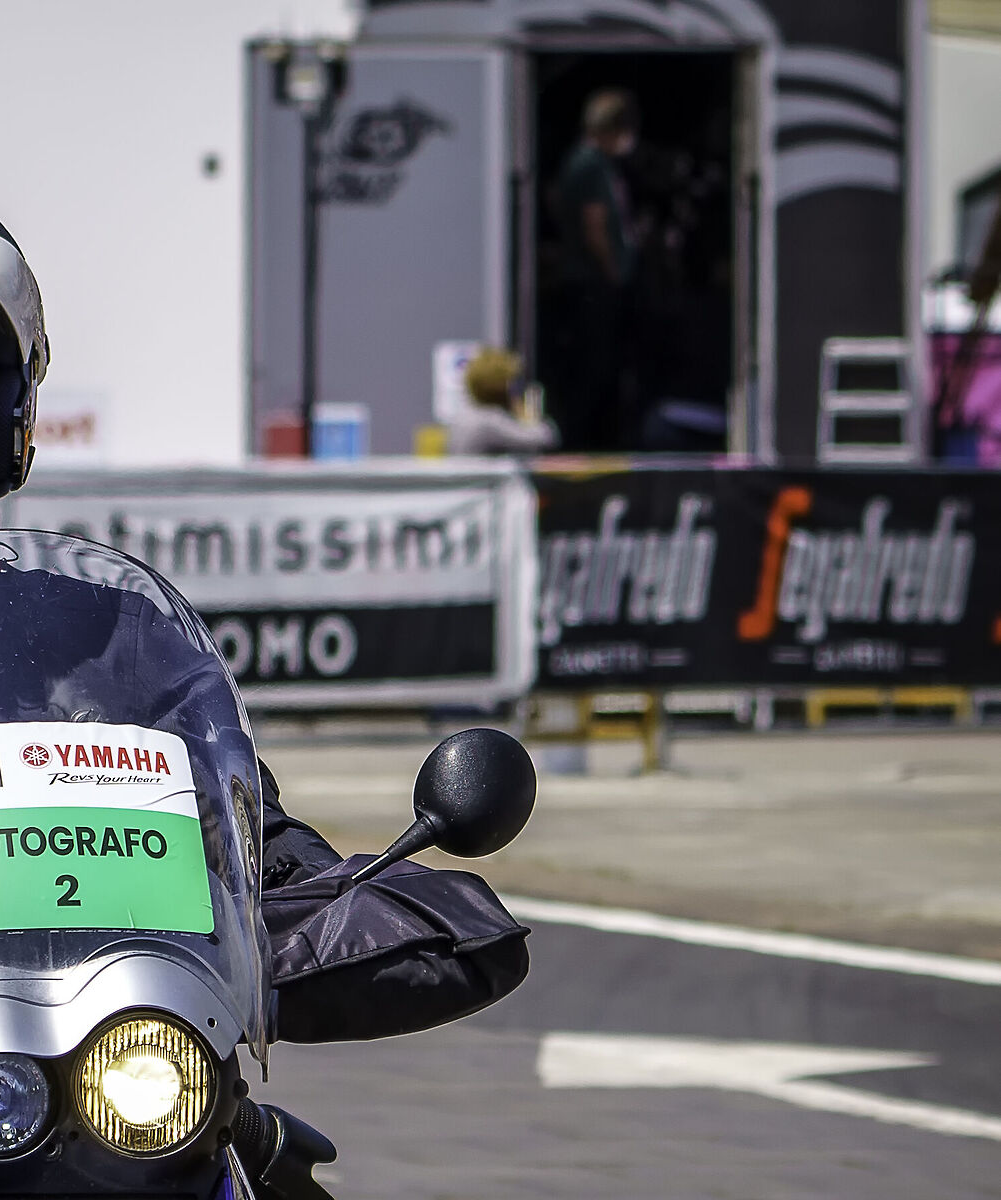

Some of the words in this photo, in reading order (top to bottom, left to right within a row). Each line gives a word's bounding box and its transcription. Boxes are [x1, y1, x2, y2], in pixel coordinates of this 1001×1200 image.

[57, 511, 482, 577] timissimi
[54, 744, 171, 775] YAMAHA
[47, 773, 95, 786] Revs
[95, 774, 127, 785] Your
[128, 776, 162, 784] Heart
[55, 874, 82, 907] 2
